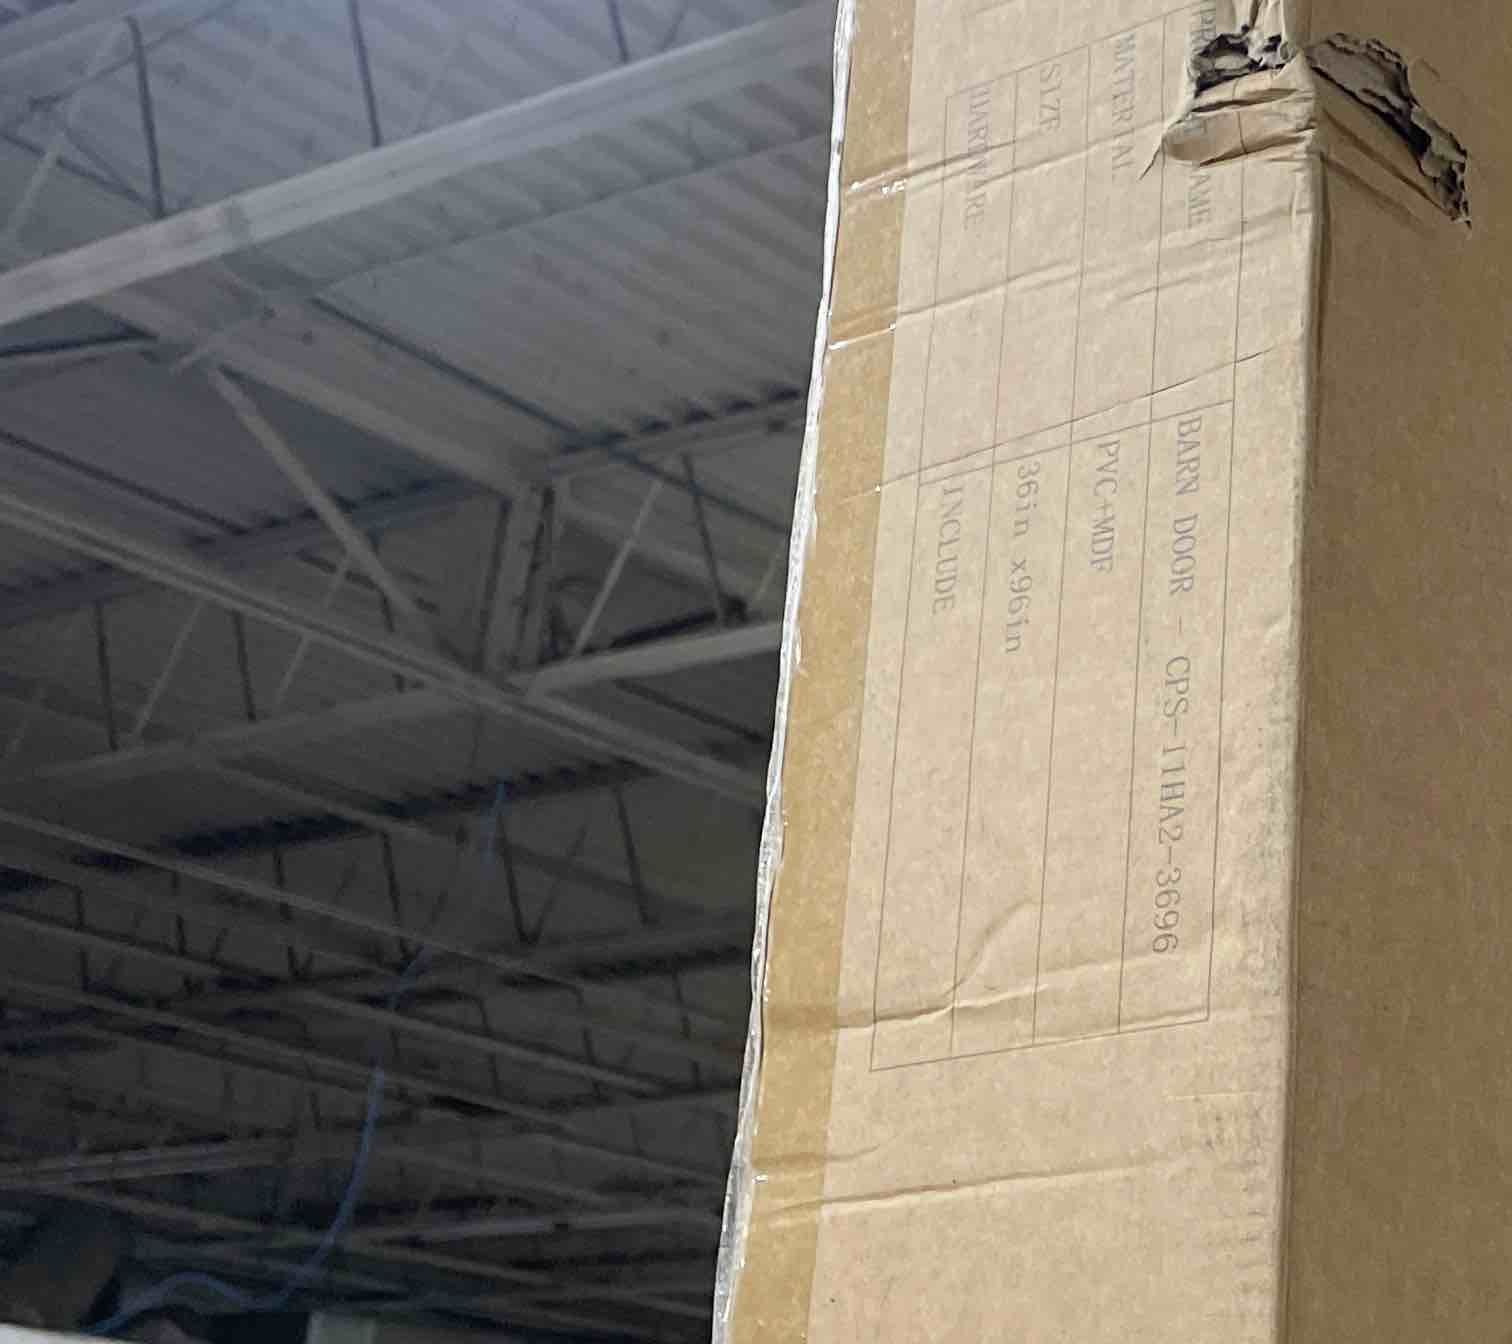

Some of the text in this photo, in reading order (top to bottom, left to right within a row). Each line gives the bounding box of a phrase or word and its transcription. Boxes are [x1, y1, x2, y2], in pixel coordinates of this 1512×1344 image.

[964, 82, 991, 232] HARDWARE
[1039, 61, 1063, 137] SIZE
[1111, 32, 1138, 184] MATERIAL
[1089, 438, 1121, 573] PVC+MDF
[1174, 414, 1202, 497] BARN
[932, 483, 965, 616] INCLUDE
[1004, 459, 1041, 654] 36in x96in
[1169, 512, 1199, 596] DOOR
[1151, 655, 1191, 954] CPS-11HA2-3696
